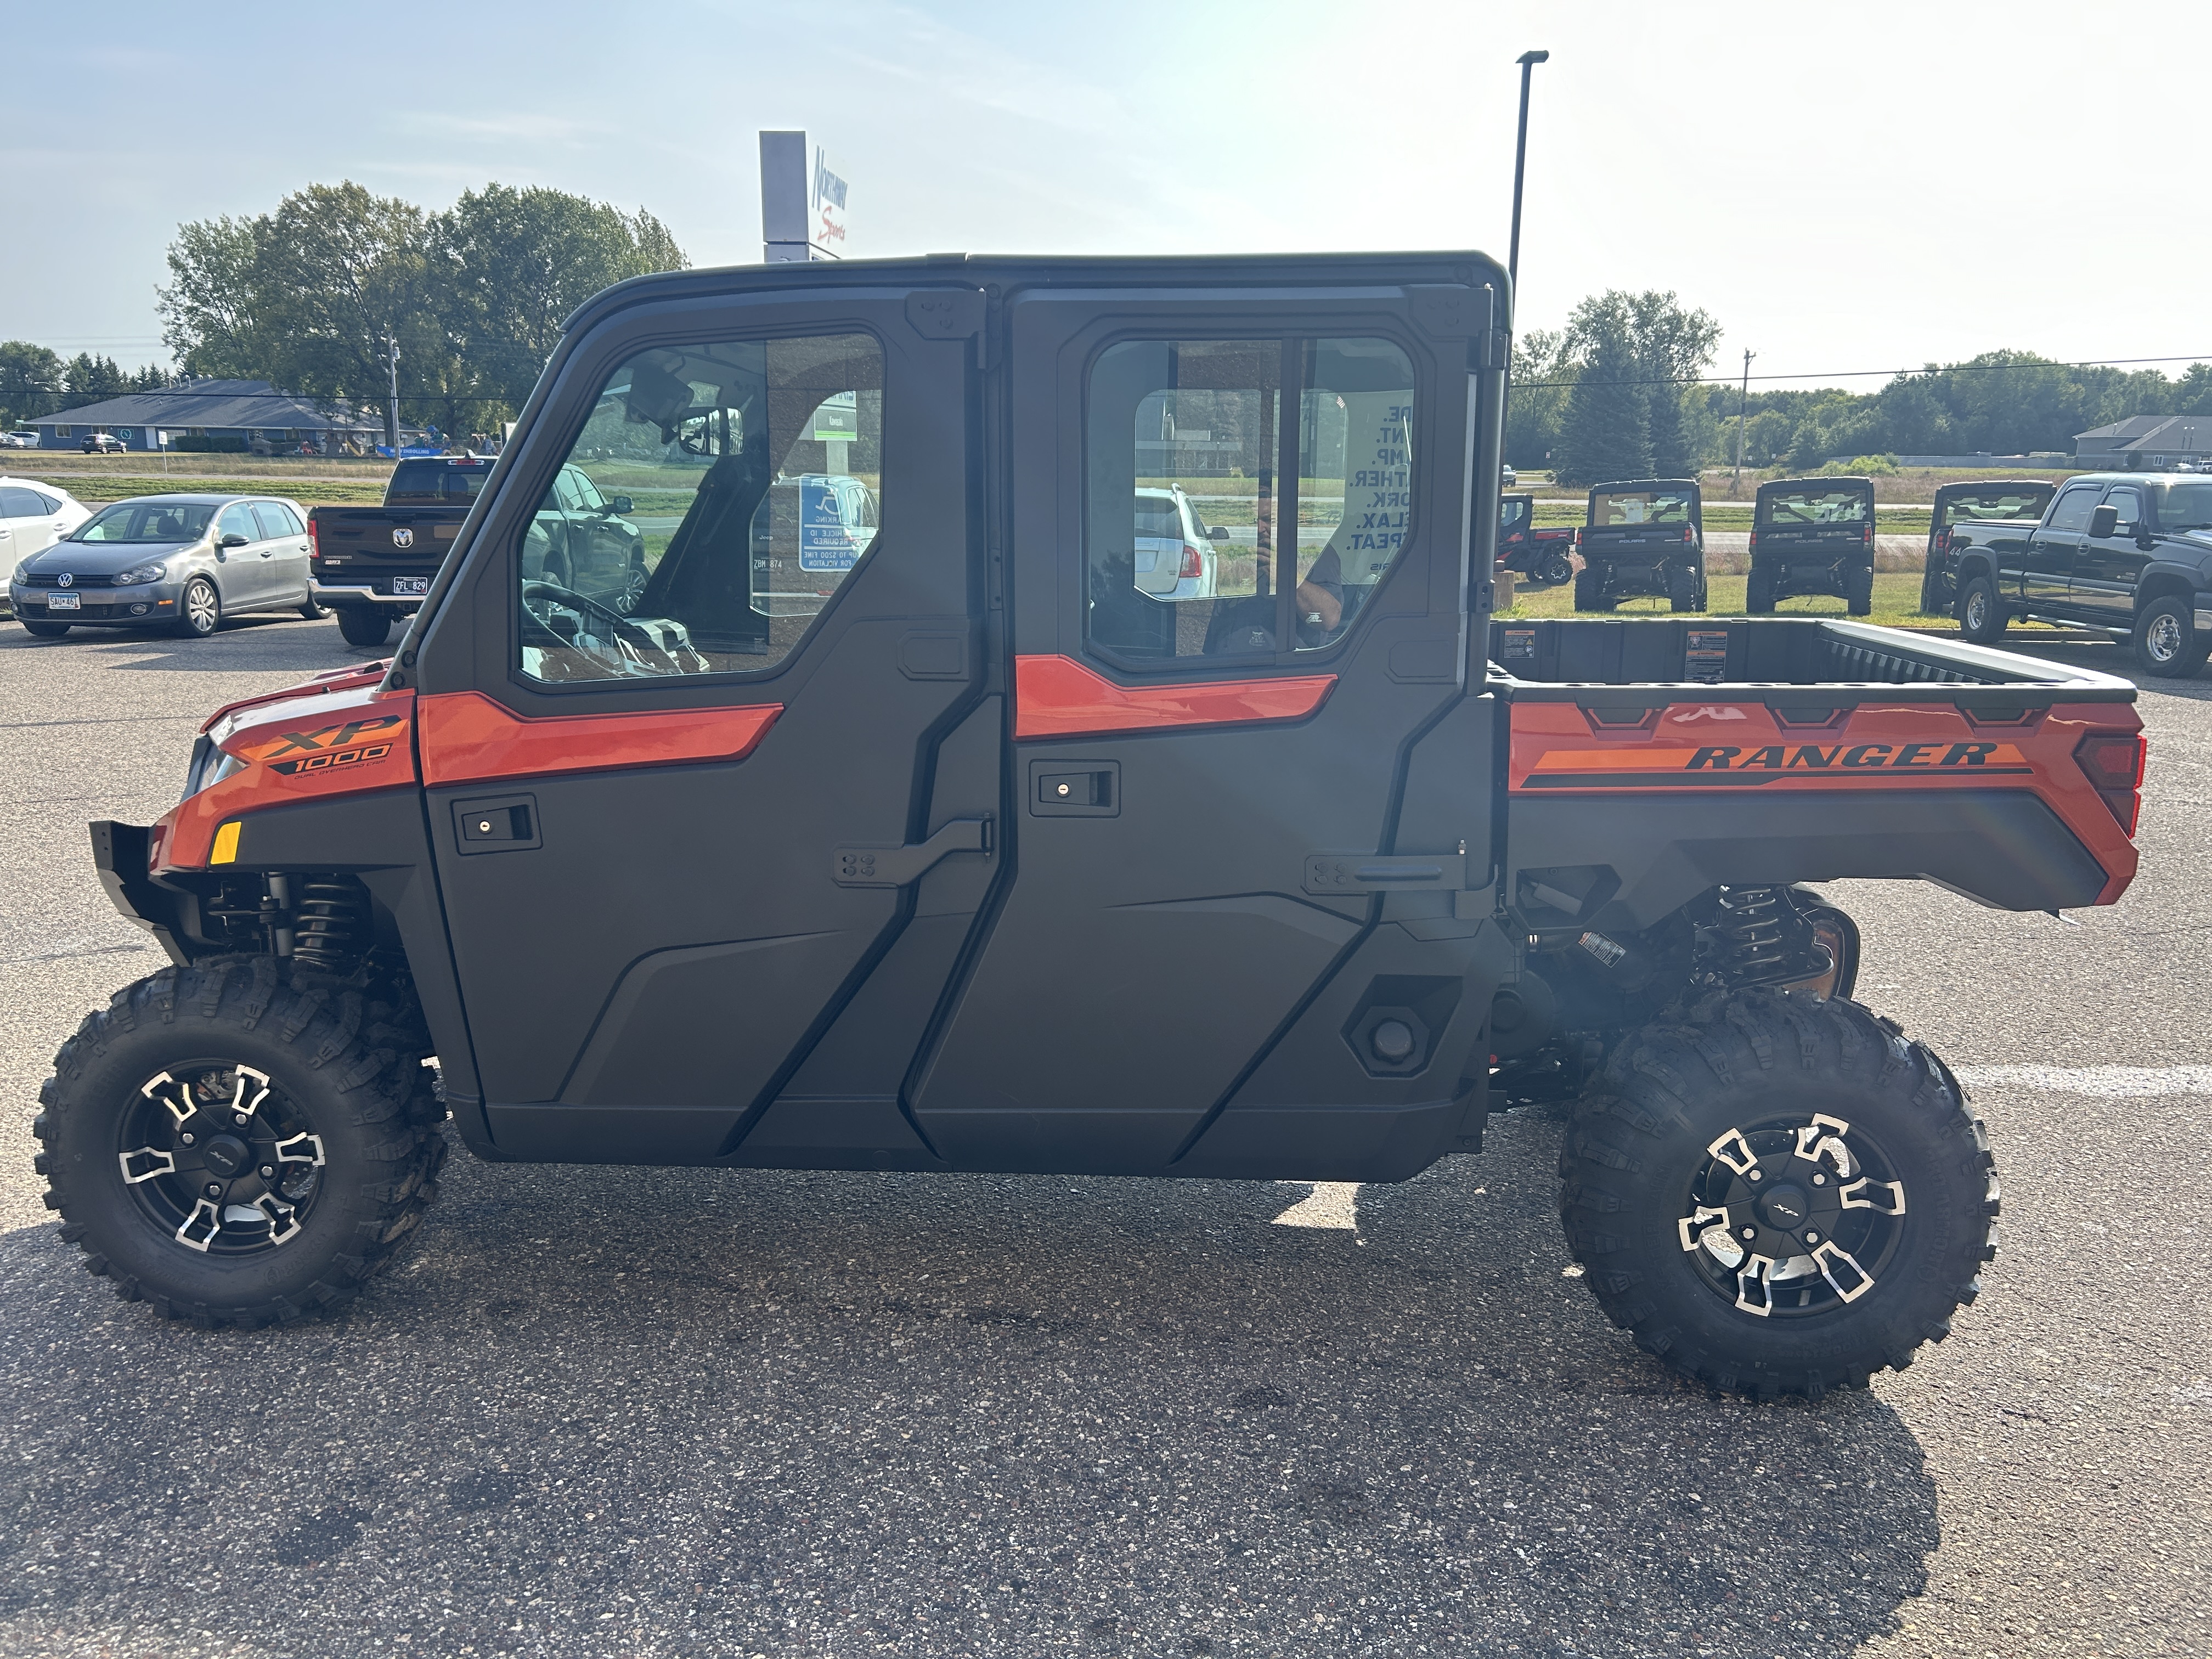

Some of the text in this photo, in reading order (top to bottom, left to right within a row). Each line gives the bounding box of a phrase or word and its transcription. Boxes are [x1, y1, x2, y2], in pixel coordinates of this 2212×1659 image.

[770, 560, 782, 568] 874
[396, 581, 426, 590] ZFL 829
[262, 714, 403, 759] XP
[295, 744, 391, 772] 1000
[1684, 742, 1998, 770] RANGER
[319, 763, 365, 775] OVERHEAD
[210, 1151, 233, 1166] XP
[1773, 1204, 1798, 1216] XP
